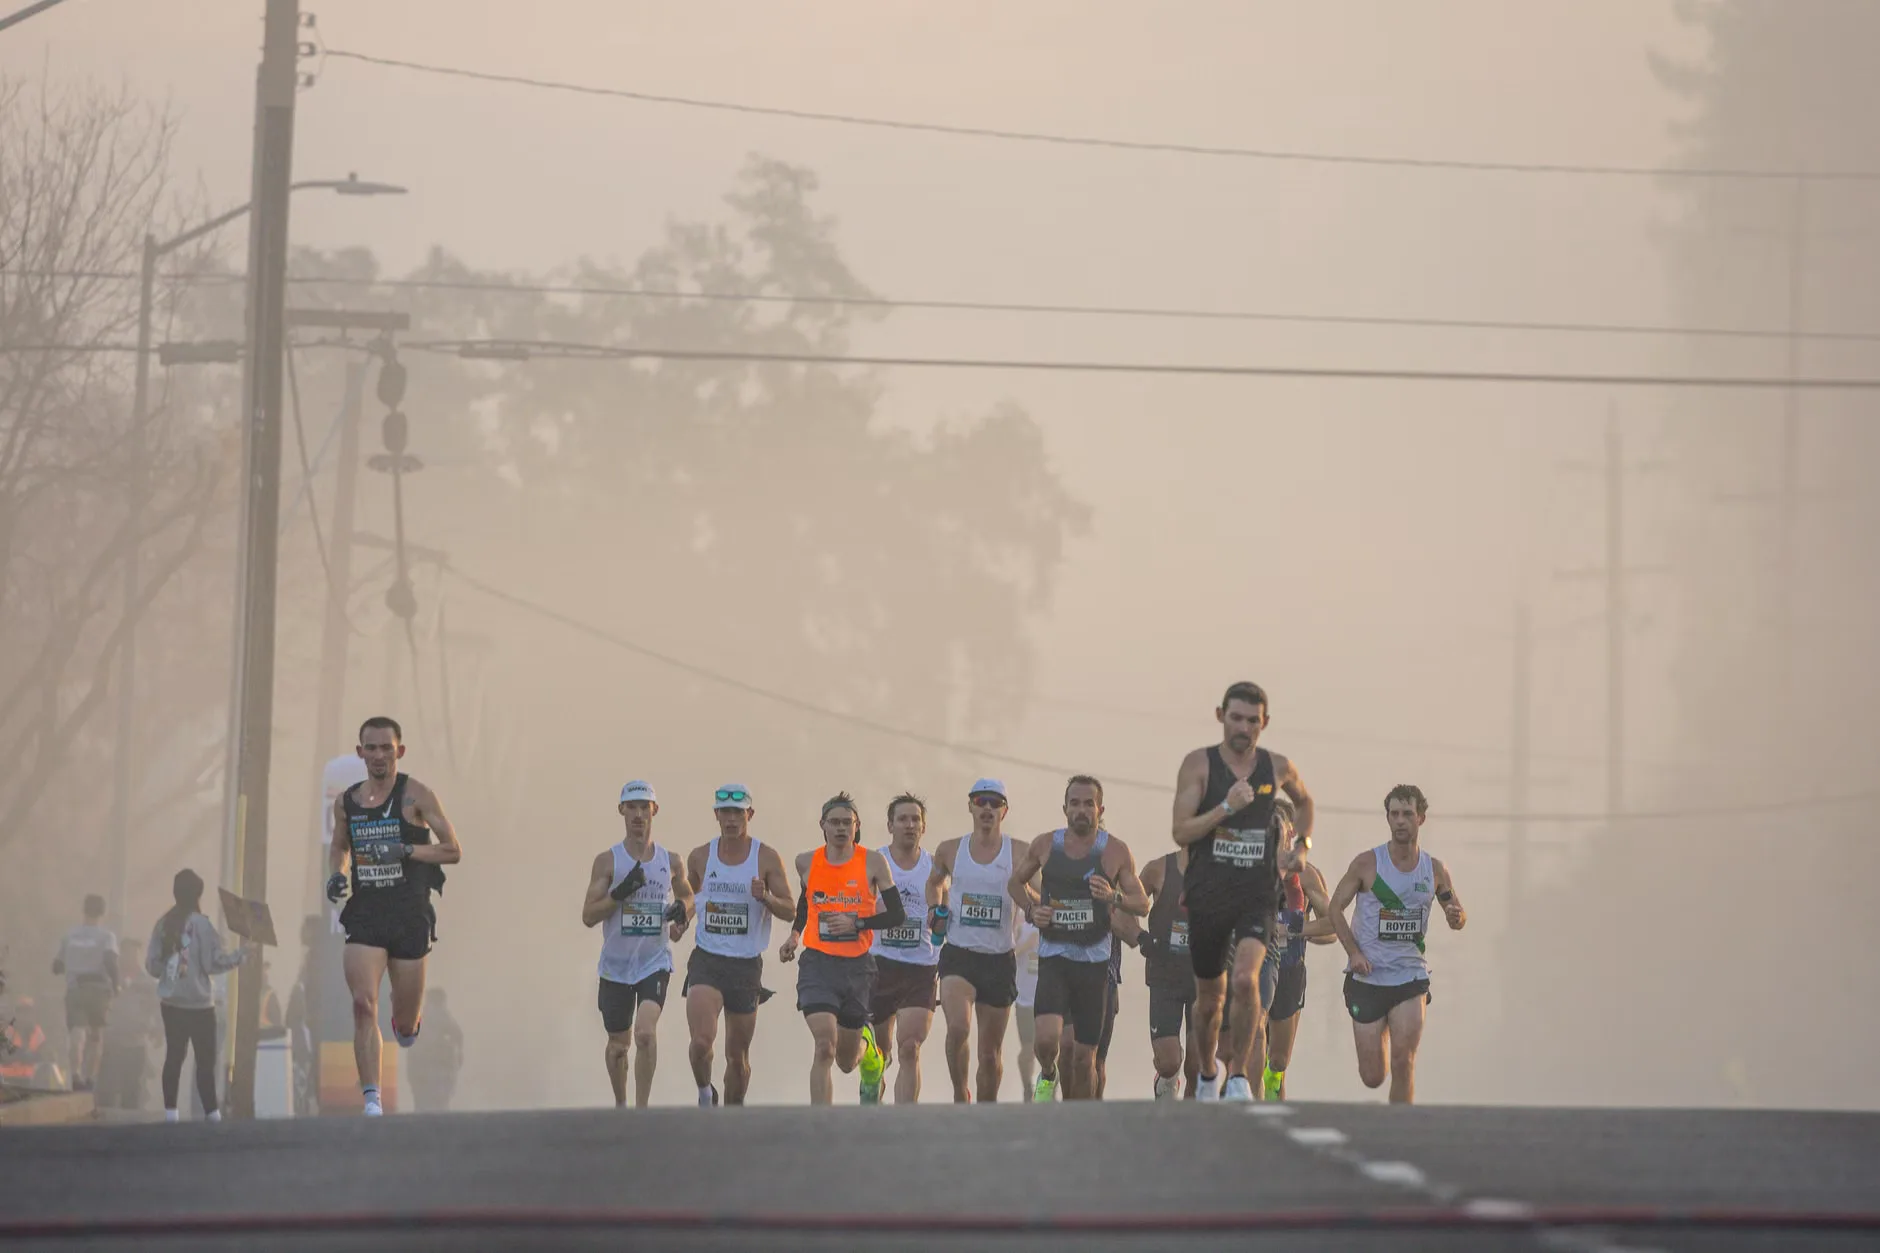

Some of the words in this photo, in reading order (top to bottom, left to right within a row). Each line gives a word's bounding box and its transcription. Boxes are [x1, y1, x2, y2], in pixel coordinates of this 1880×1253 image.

[356, 824, 400, 836] RUNNING
[1215, 841, 1264, 856] MCCANN
[358, 866, 401, 877] SULTANOV
[966, 906, 994, 919] 4561
[1056, 911, 1087, 921] PACER
[631, 915, 653, 926] 324
[709, 914, 743, 926] GARCIA
[1385, 921, 1417, 932] ROYER
[886, 928, 915, 939] 8309
